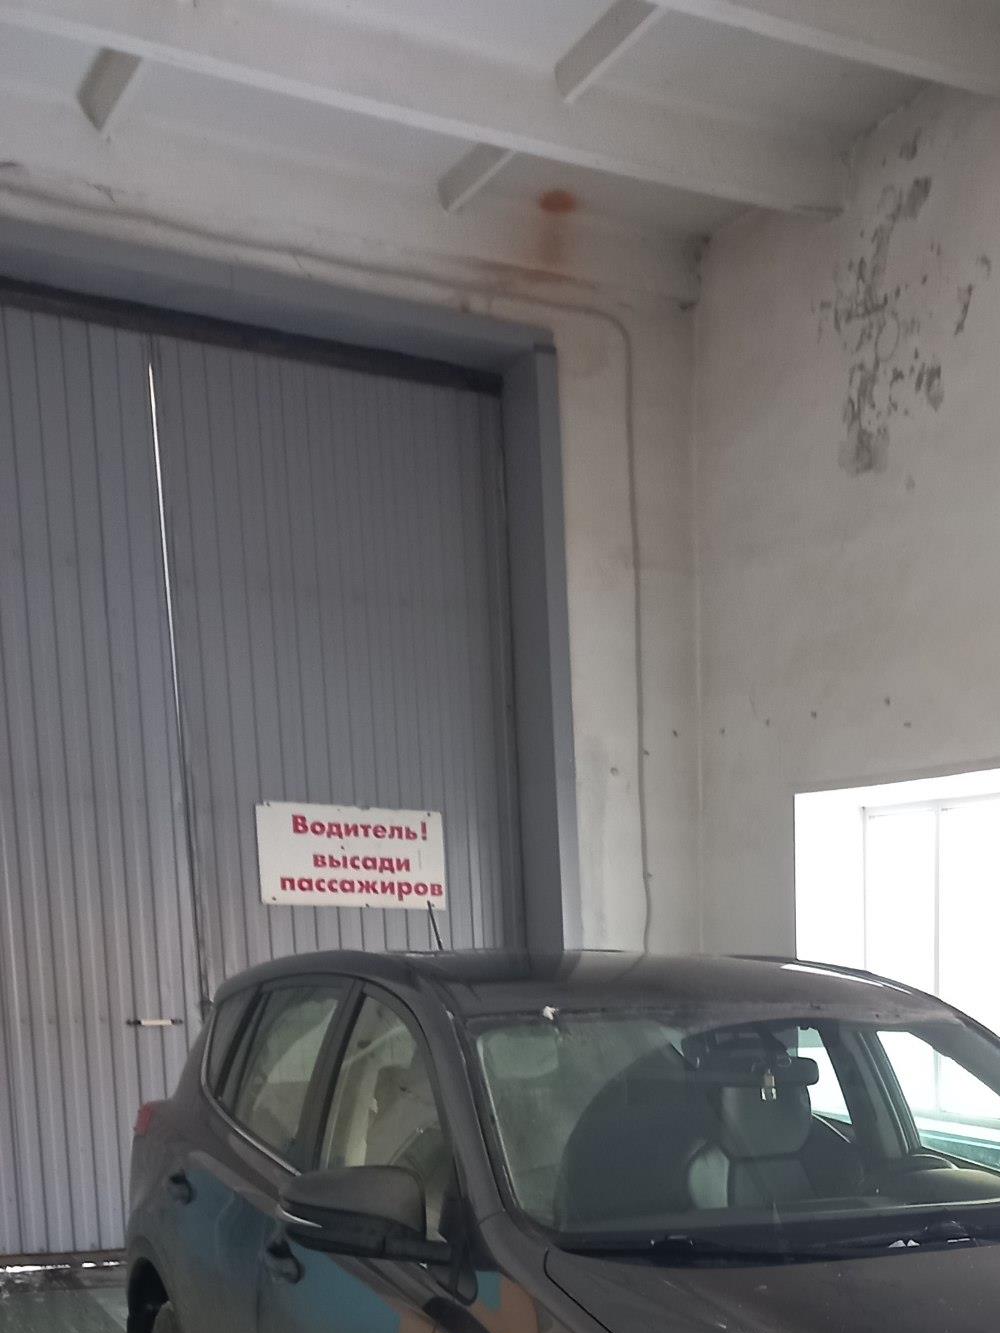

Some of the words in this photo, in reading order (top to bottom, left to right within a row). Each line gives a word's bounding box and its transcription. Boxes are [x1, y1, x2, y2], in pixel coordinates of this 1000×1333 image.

[291, 814, 428, 841] Водитель!
[312, 853, 411, 874] высади
[279, 876, 444, 902] пассажиров
